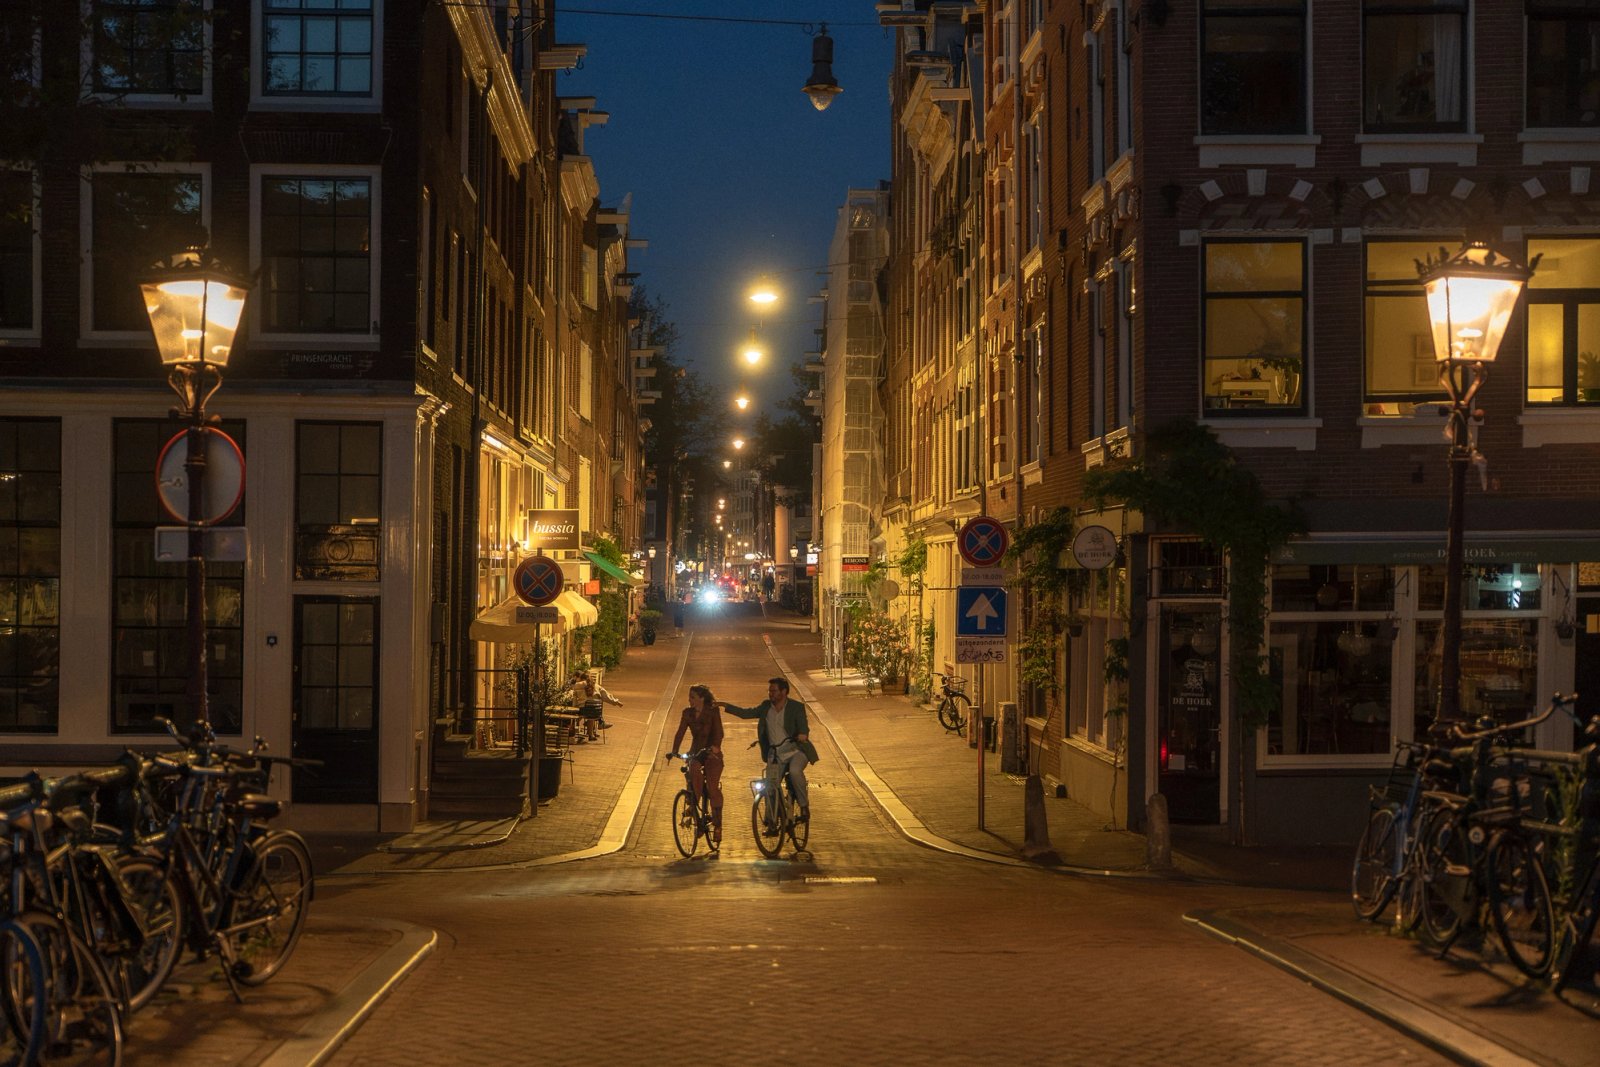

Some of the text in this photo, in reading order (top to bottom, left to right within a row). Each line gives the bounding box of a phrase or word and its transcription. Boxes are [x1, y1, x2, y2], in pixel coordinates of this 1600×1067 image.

[291, 354, 352, 363] PRINSENGRACHT
[533, 520, 575, 534] bussia
[1172, 697, 1212, 706] DE HOEK
